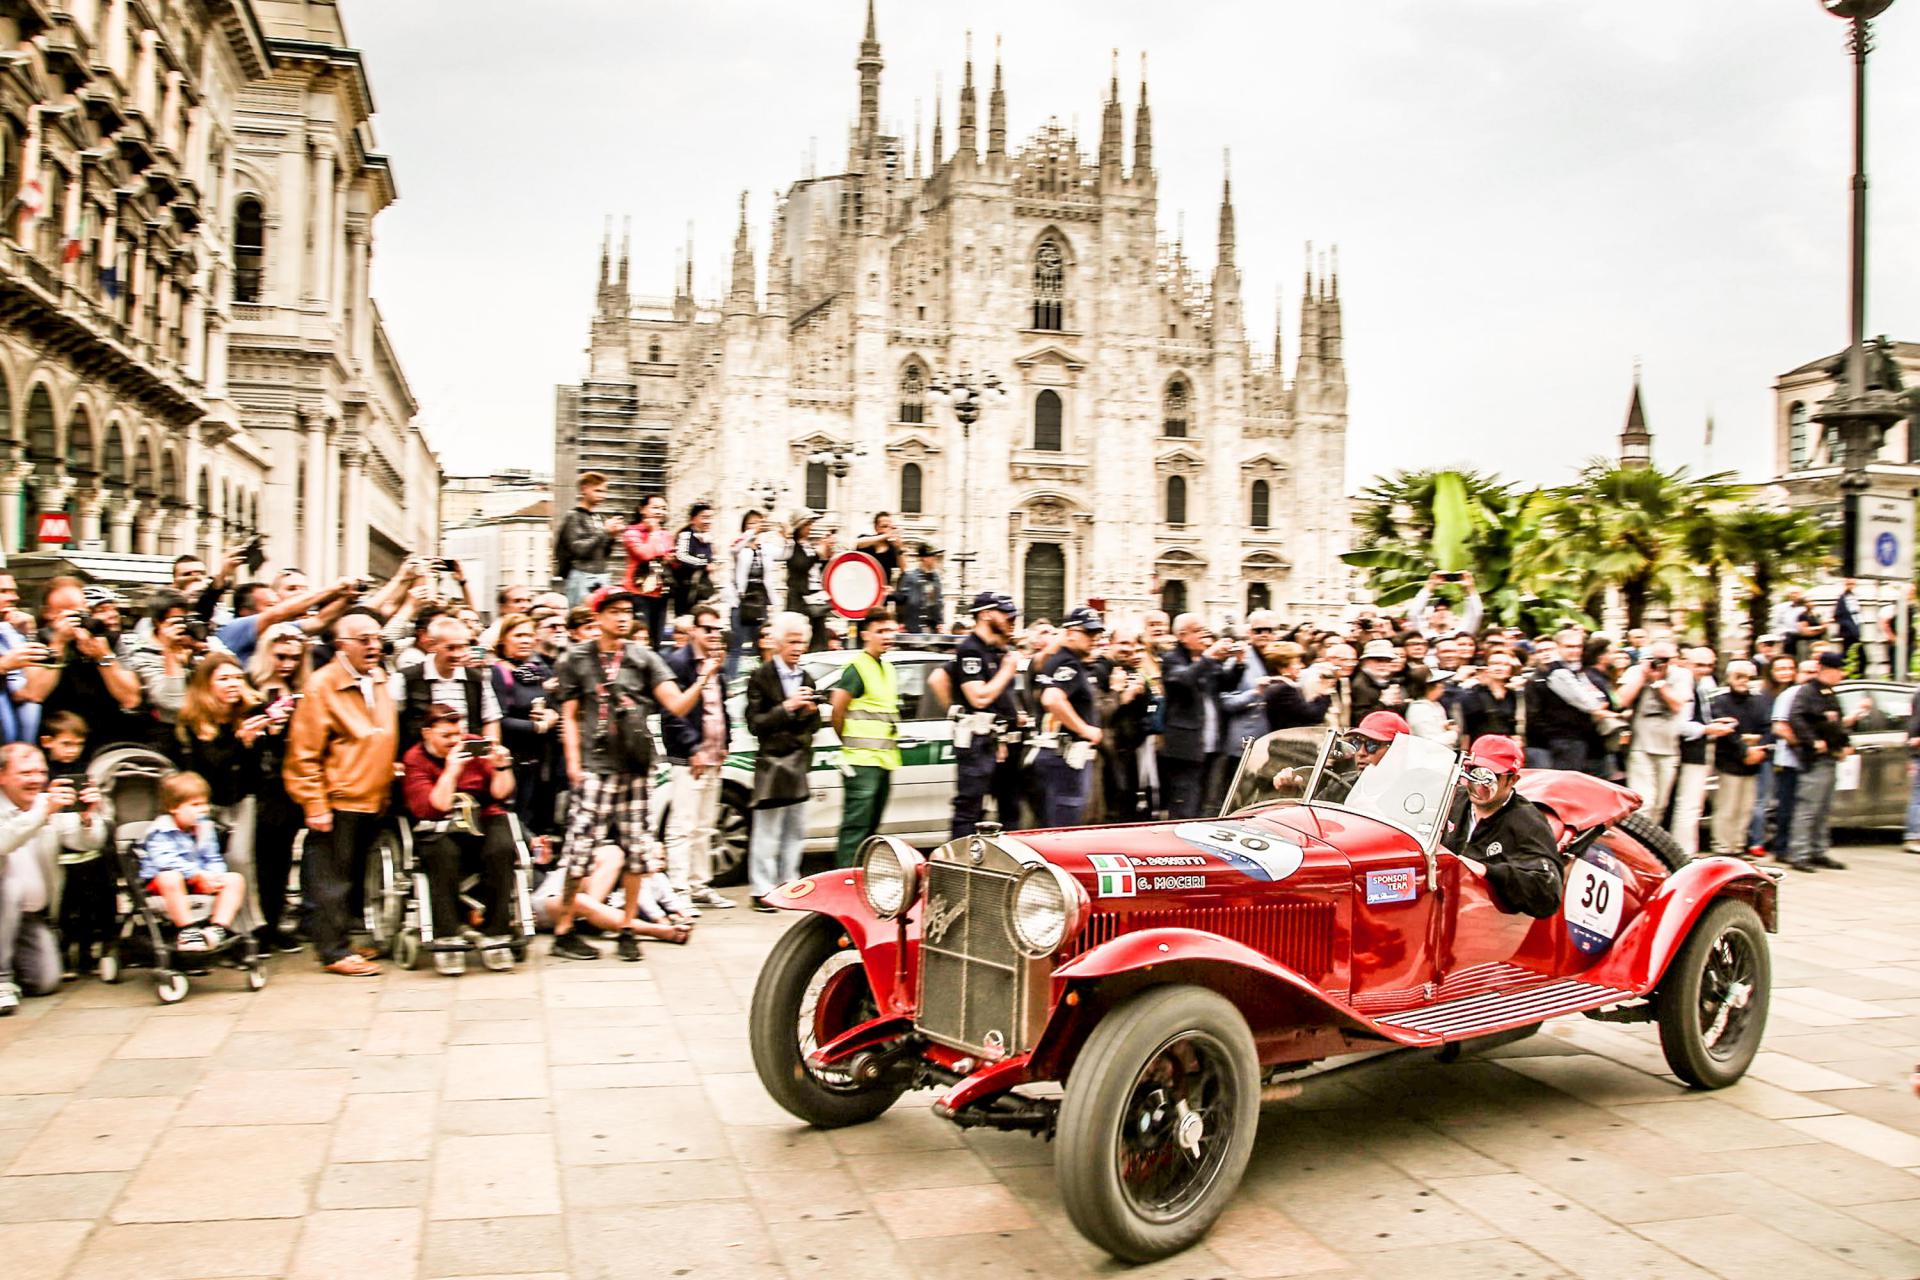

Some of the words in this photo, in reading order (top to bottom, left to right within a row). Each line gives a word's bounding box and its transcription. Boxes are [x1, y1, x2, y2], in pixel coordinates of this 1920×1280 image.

[1209, 829, 1270, 851] 30
[1137, 876, 1152, 890] G.
[1154, 876, 1206, 890] MOCERI
[1373, 873, 1408, 885] SPONSOR
[1387, 882, 1408, 891] TEAM
[1581, 873, 1609, 914] 30
